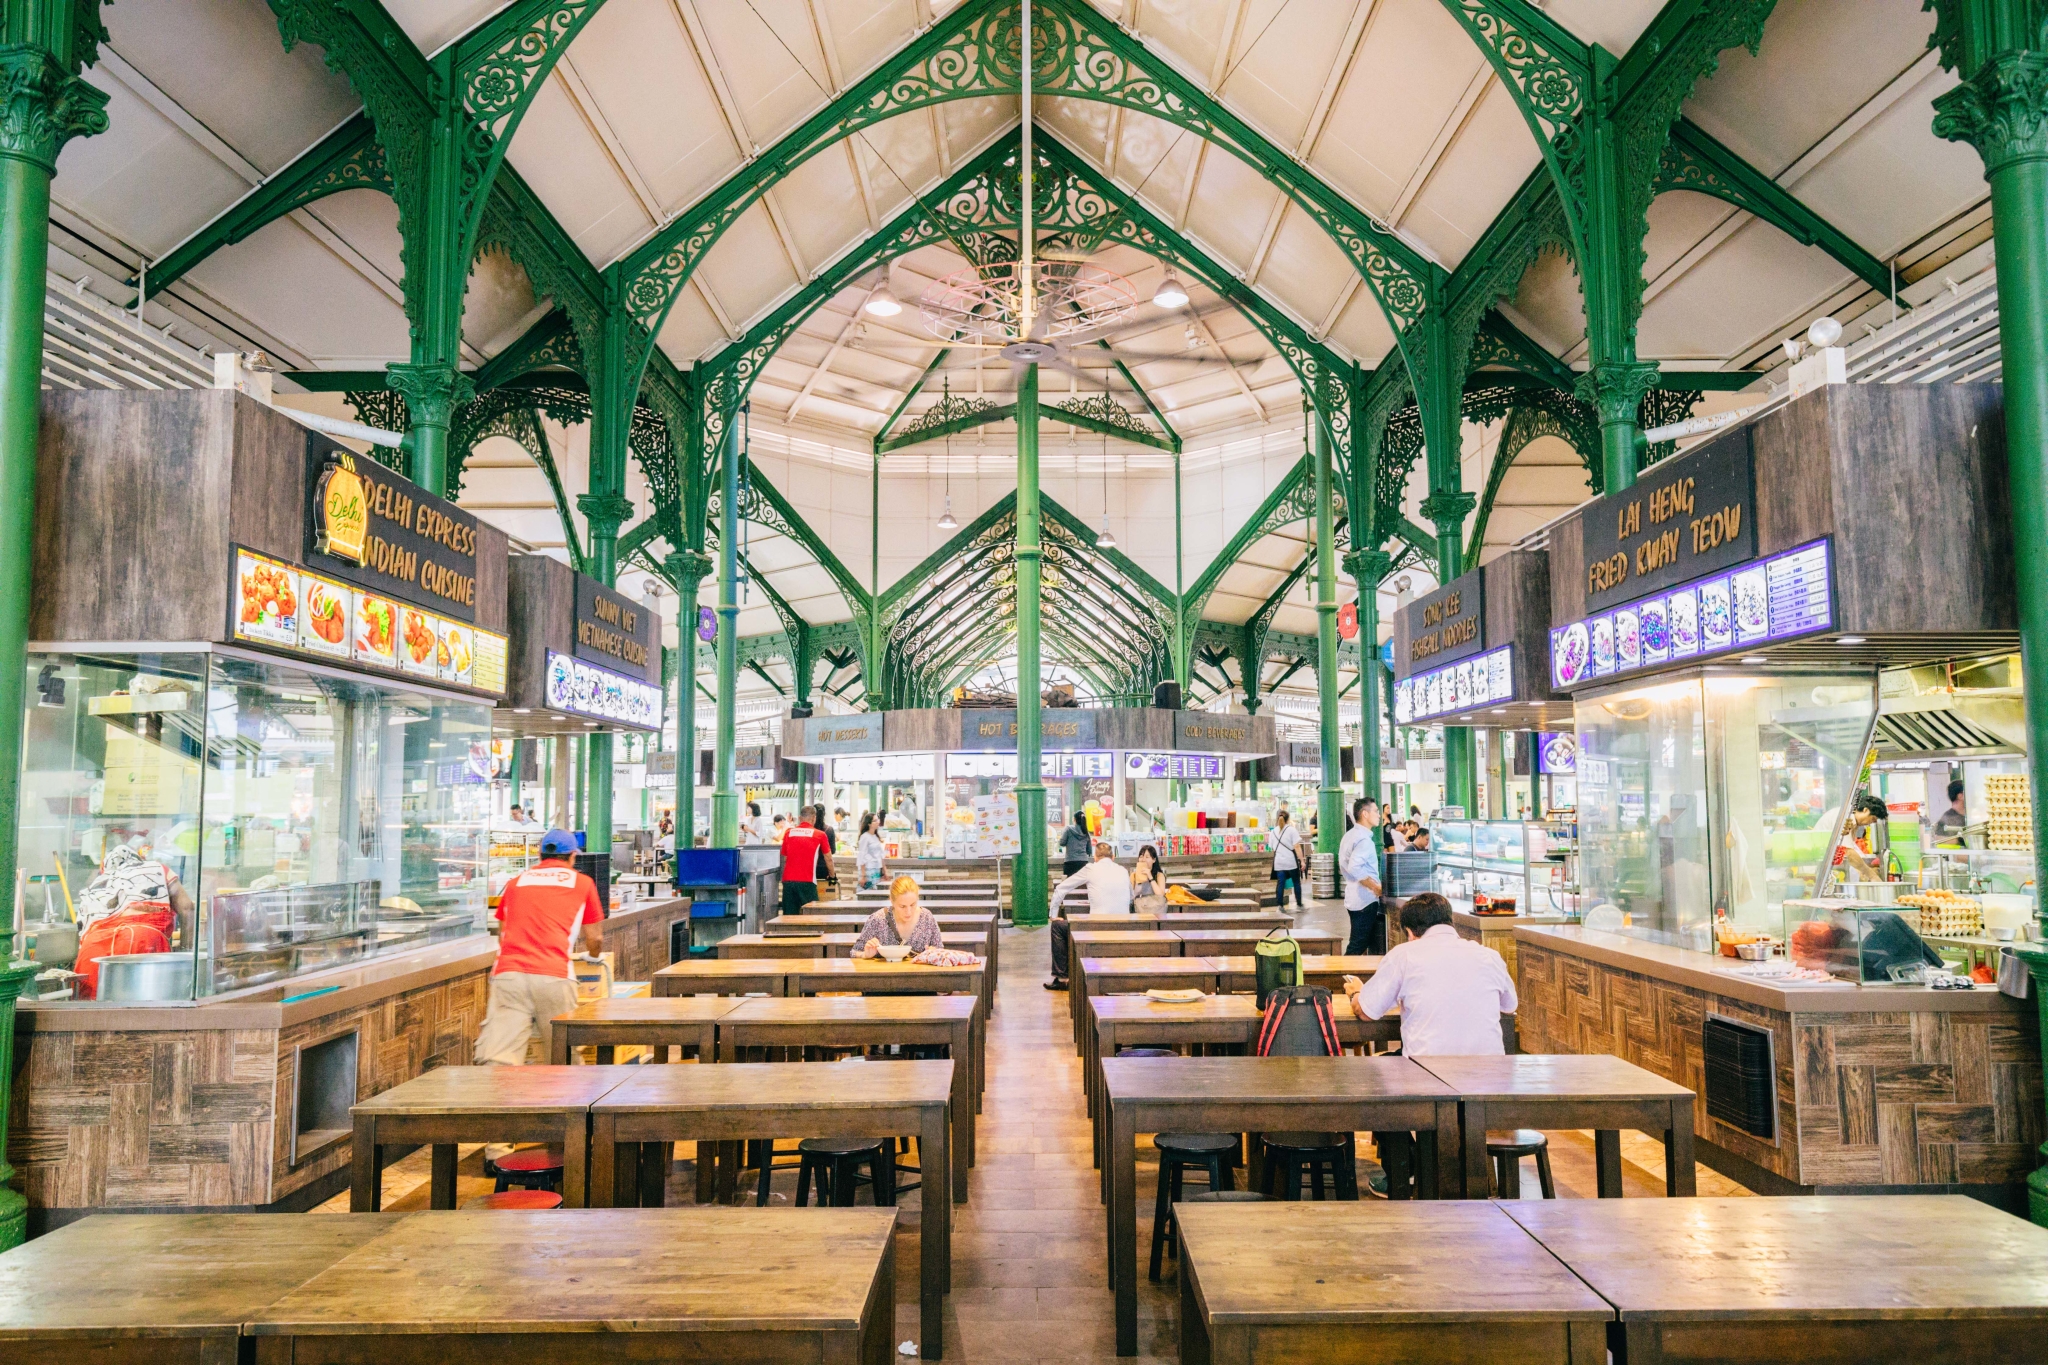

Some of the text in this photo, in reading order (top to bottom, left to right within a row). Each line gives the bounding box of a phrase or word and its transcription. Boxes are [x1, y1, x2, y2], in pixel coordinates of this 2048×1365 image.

[327, 492, 364, 523] Delhi
[363, 474, 477, 557] DELHI EXPRESS
[1618, 477, 1695, 541] LAI HENG
[1588, 503, 1742, 594] FRIED KWAY TEOW
[364, 535, 475, 606] NDIAN CUISINE
[1423, 590, 1461, 629] SONG KEE
[1443, 614, 1477, 650] NOODLES
[818, 728, 868, 742] HOT DESSERTS
[979, 723, 1003, 736] HOT
[1185, 725, 1246, 741] COLD BEVERAGES
